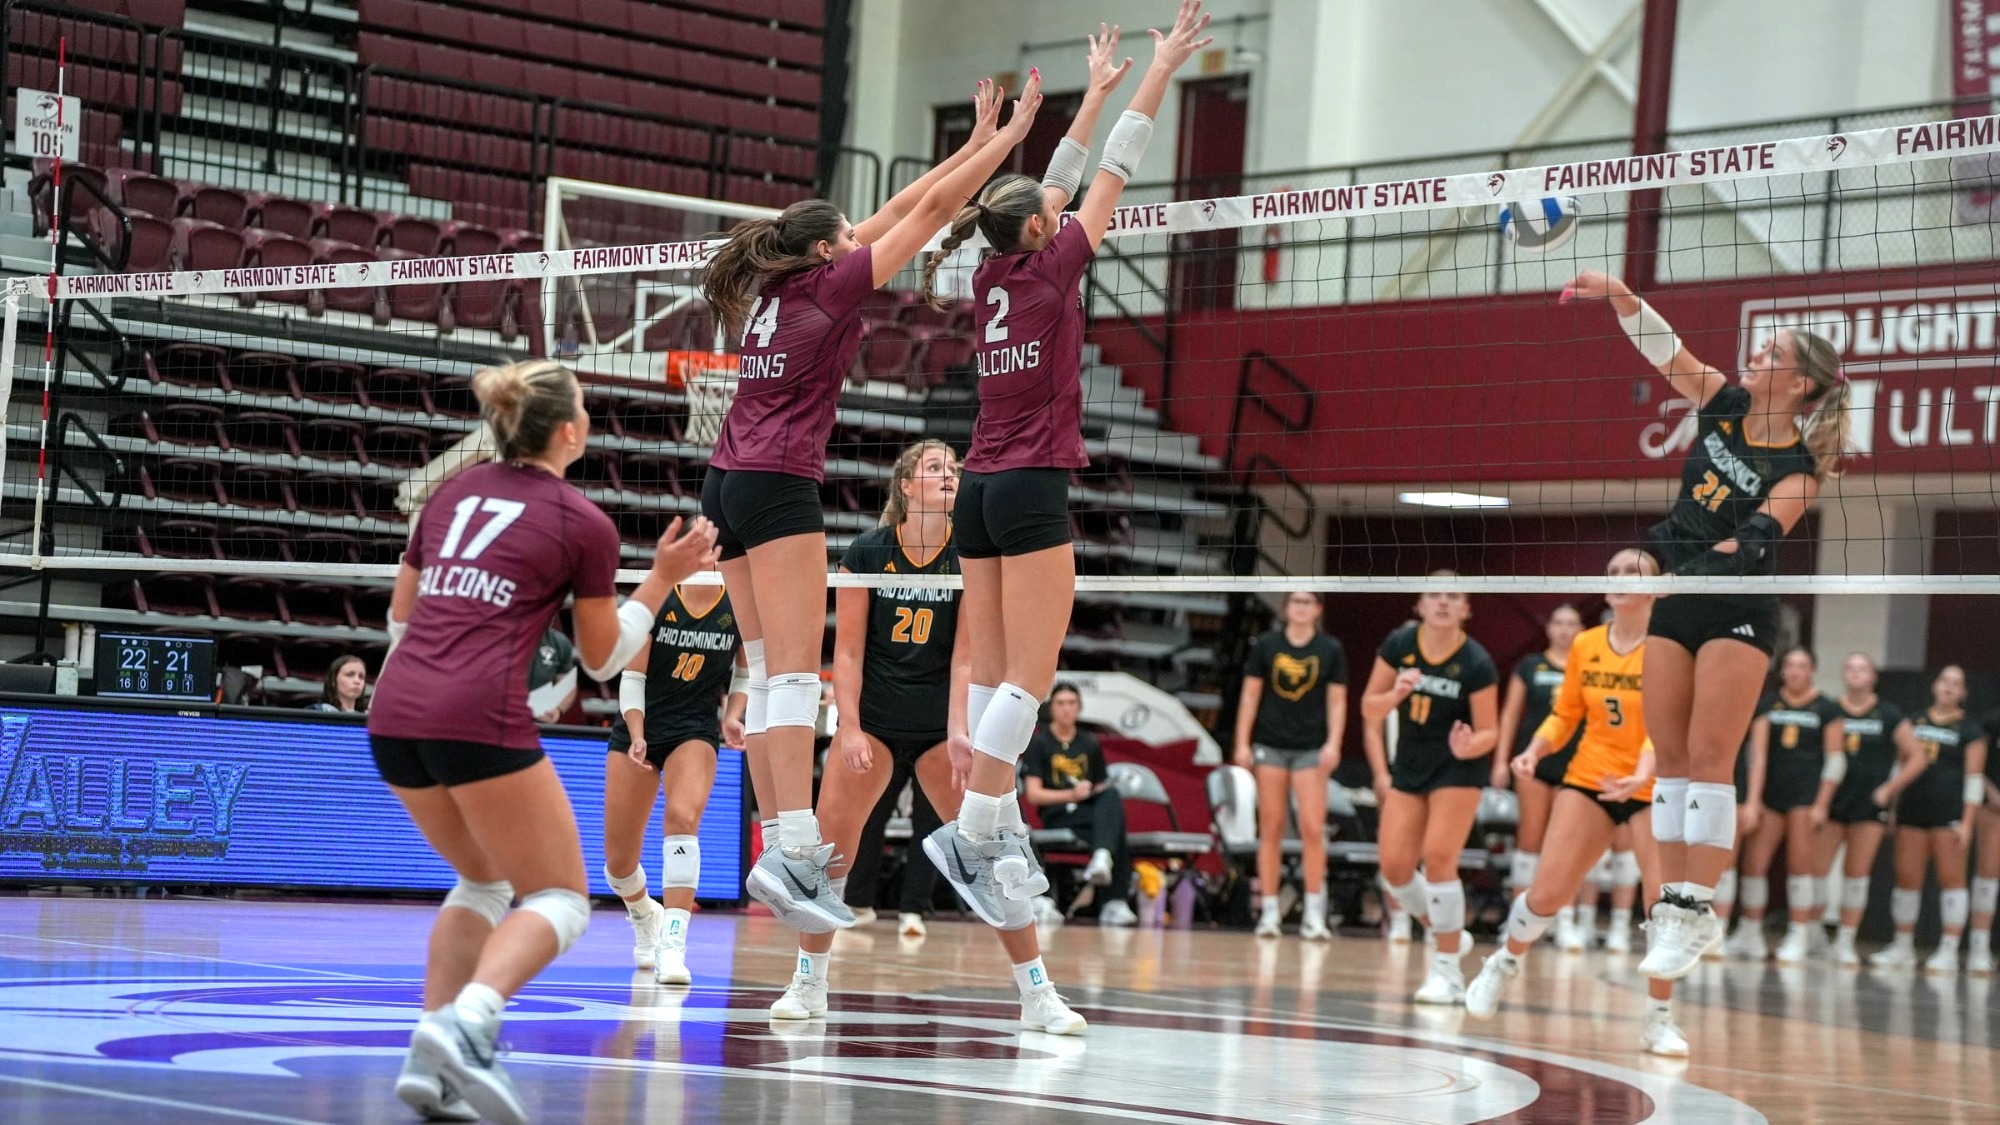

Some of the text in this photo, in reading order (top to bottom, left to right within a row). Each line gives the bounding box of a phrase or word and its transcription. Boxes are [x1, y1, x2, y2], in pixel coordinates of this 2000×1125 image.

[33, 131, 63, 157] 105
[1897, 117, 2000, 155] FAIRM
[1544, 143, 1776, 191] FAIRMONT STATE
[1253, 178, 1447, 218] FAIRMONT STATE
[391, 255, 514, 279] FAIRMONT STATE
[573, 241, 708, 270] FAIRMONT STATE
[68, 273, 173, 294] FAIRMONT STATE
[224, 265, 337, 287] FAIRMONT STATE
[740, 296, 780, 348] 14
[984, 286, 1010, 343] 2
[1751, 301, 2000, 356] BD LIGHT
[739, 353, 787, 379] CONS
[976, 340, 1041, 377] ALCONS
[1692, 469, 1732, 513] 21
[439, 495, 527, 560] 17
[417, 565, 517, 608] ALCONS
[678, 630, 735, 651] DOMINICAN
[891, 606, 934, 645] 20
[121, 648, 147, 670] 22
[166, 650, 189, 672] 21
[671, 652, 706, 682] 10
[119, 678, 191, 691] 16 0 9 1
[1409, 693, 1432, 725] 11
[1604, 697, 1624, 728] 3
